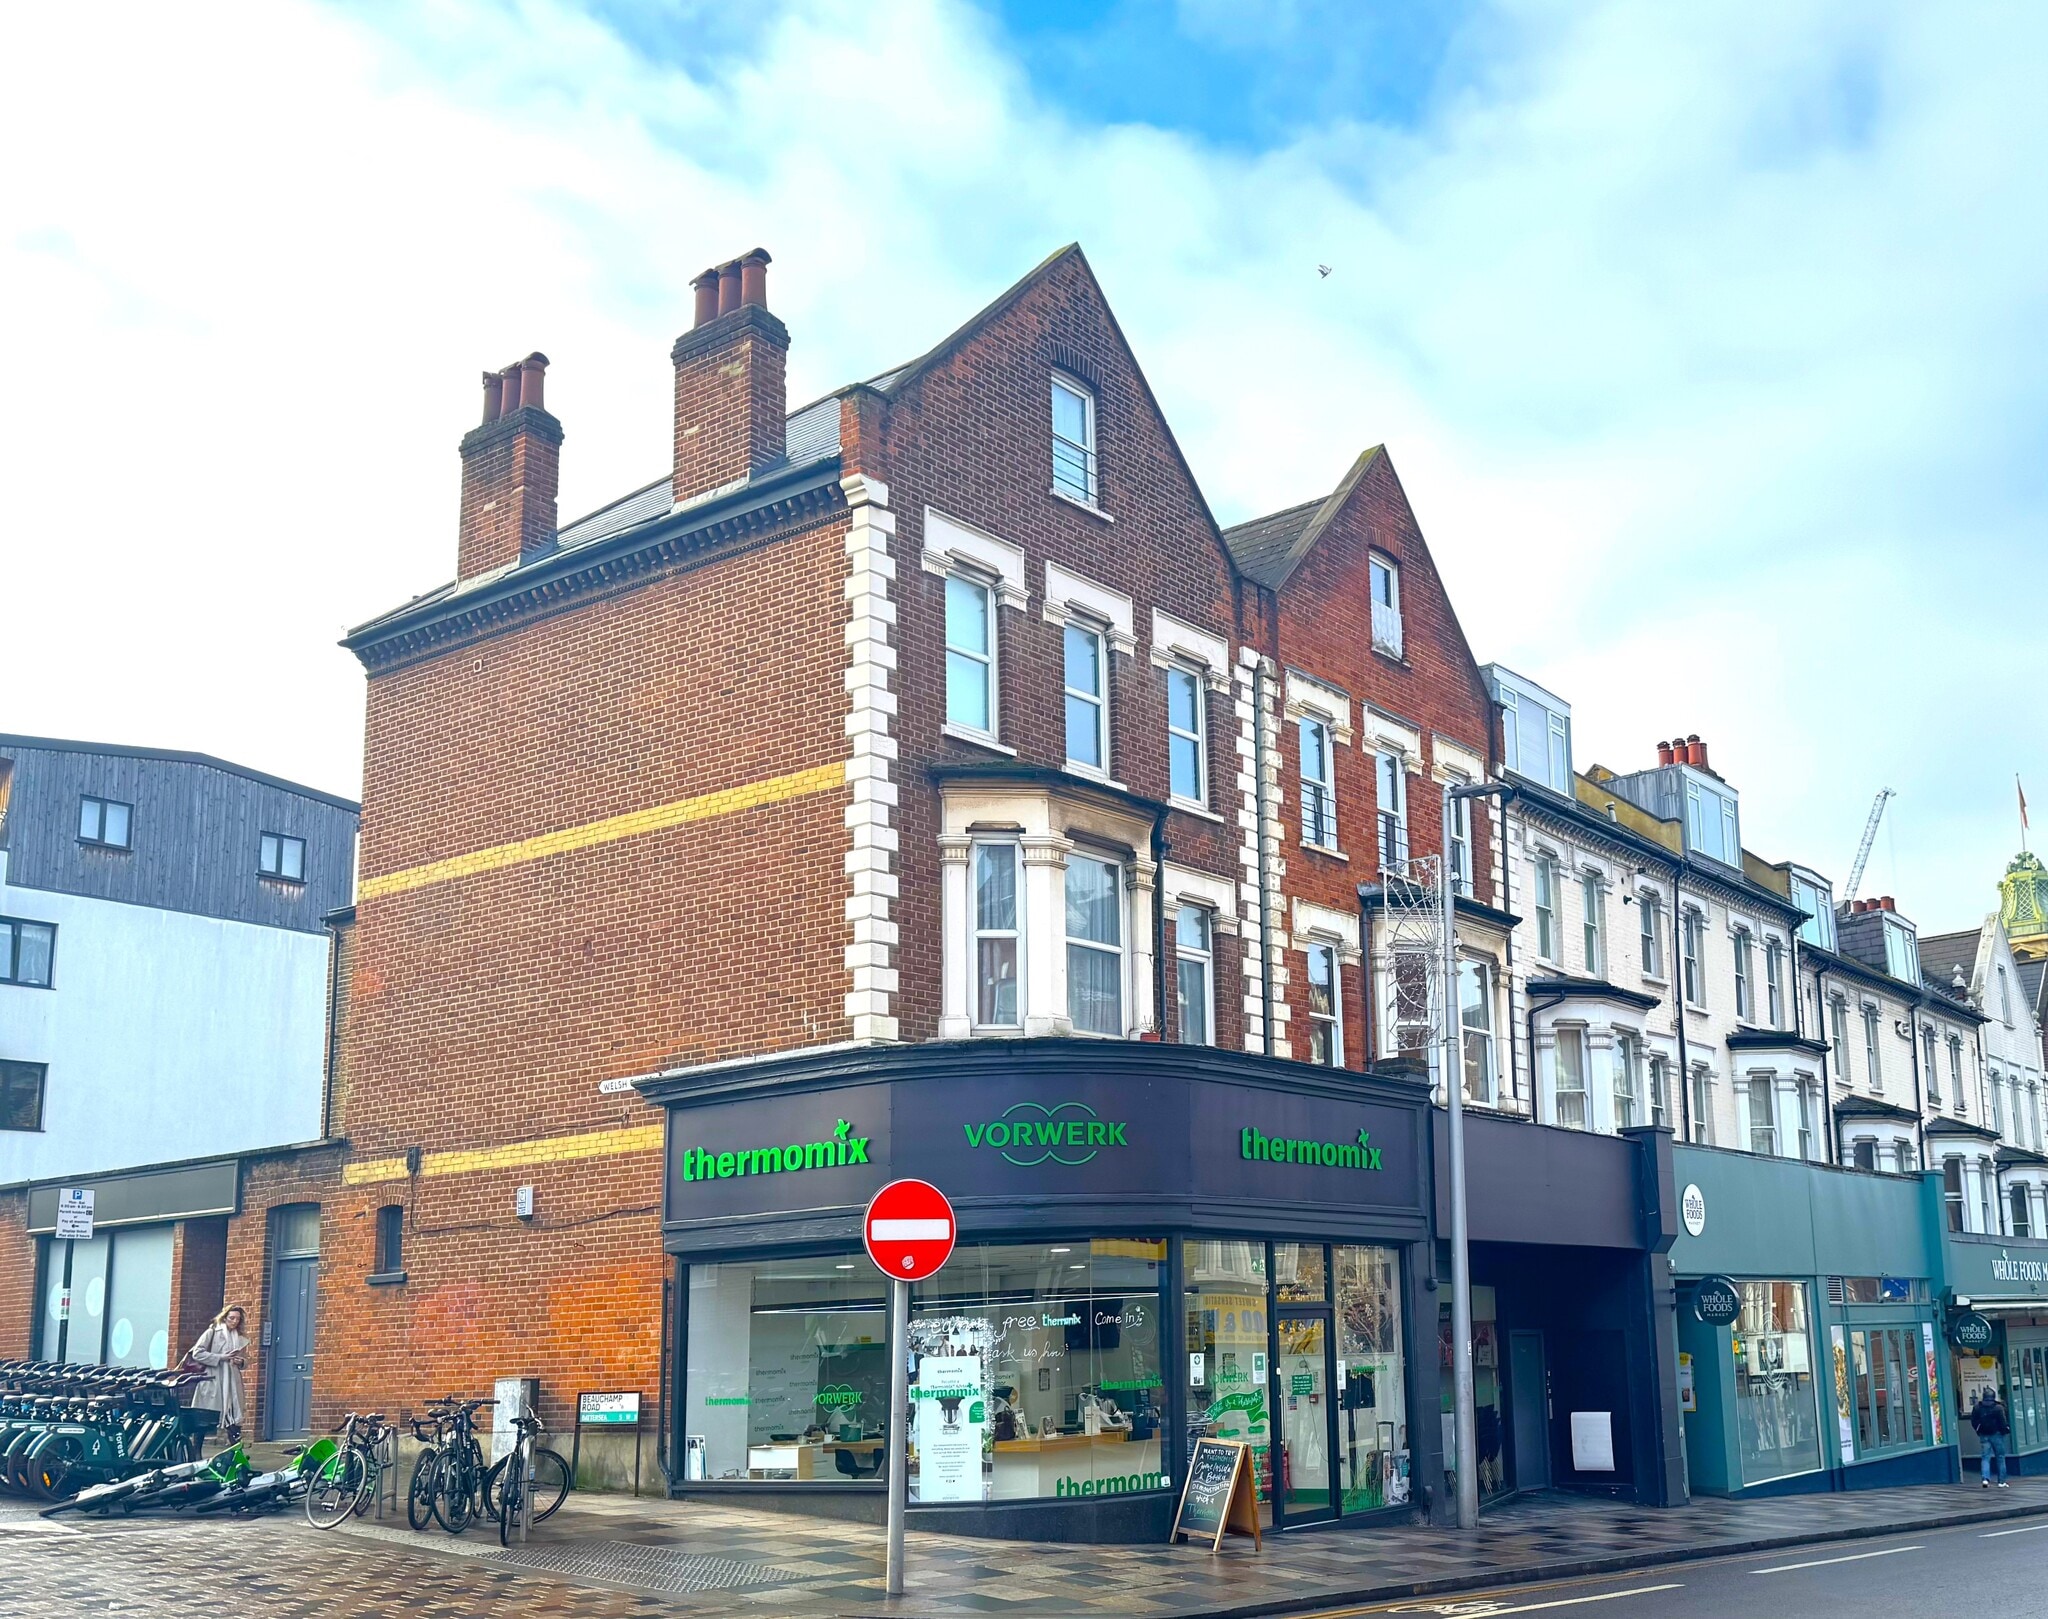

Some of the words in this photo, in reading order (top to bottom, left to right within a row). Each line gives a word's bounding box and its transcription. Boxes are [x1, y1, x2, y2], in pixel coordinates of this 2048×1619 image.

[603, 1080, 628, 1091] WELSH
[963, 1122, 1128, 1148] VORWERK
[683, 1119, 869, 1182] thermomix
[1241, 1127, 1383, 1170] thermomix
[1685, 1199, 1702, 1210] WHOLE
[1686, 1209, 1703, 1220] FOODS
[1992, 1260, 2018, 1281] WHOLE
[2019, 1261, 2041, 1281] FOODS
[1701, 1294, 1733, 1303] WHOLE
[1703, 1303, 1733, 1312] FOODS
[1095, 1311, 1122, 1326] Come
[1960, 1325, 1987, 1333] WHOLE
[1962, 1332, 1987, 1340] FOODS
[910, 1382, 980, 1399] thermomix
[582, 1394, 623, 1404] BEAUCHAMP
[581, 1403, 601, 1411] ROAD
[115, 1432, 126, 1458] forest
[1203, 1447, 1218, 1455] WANT
